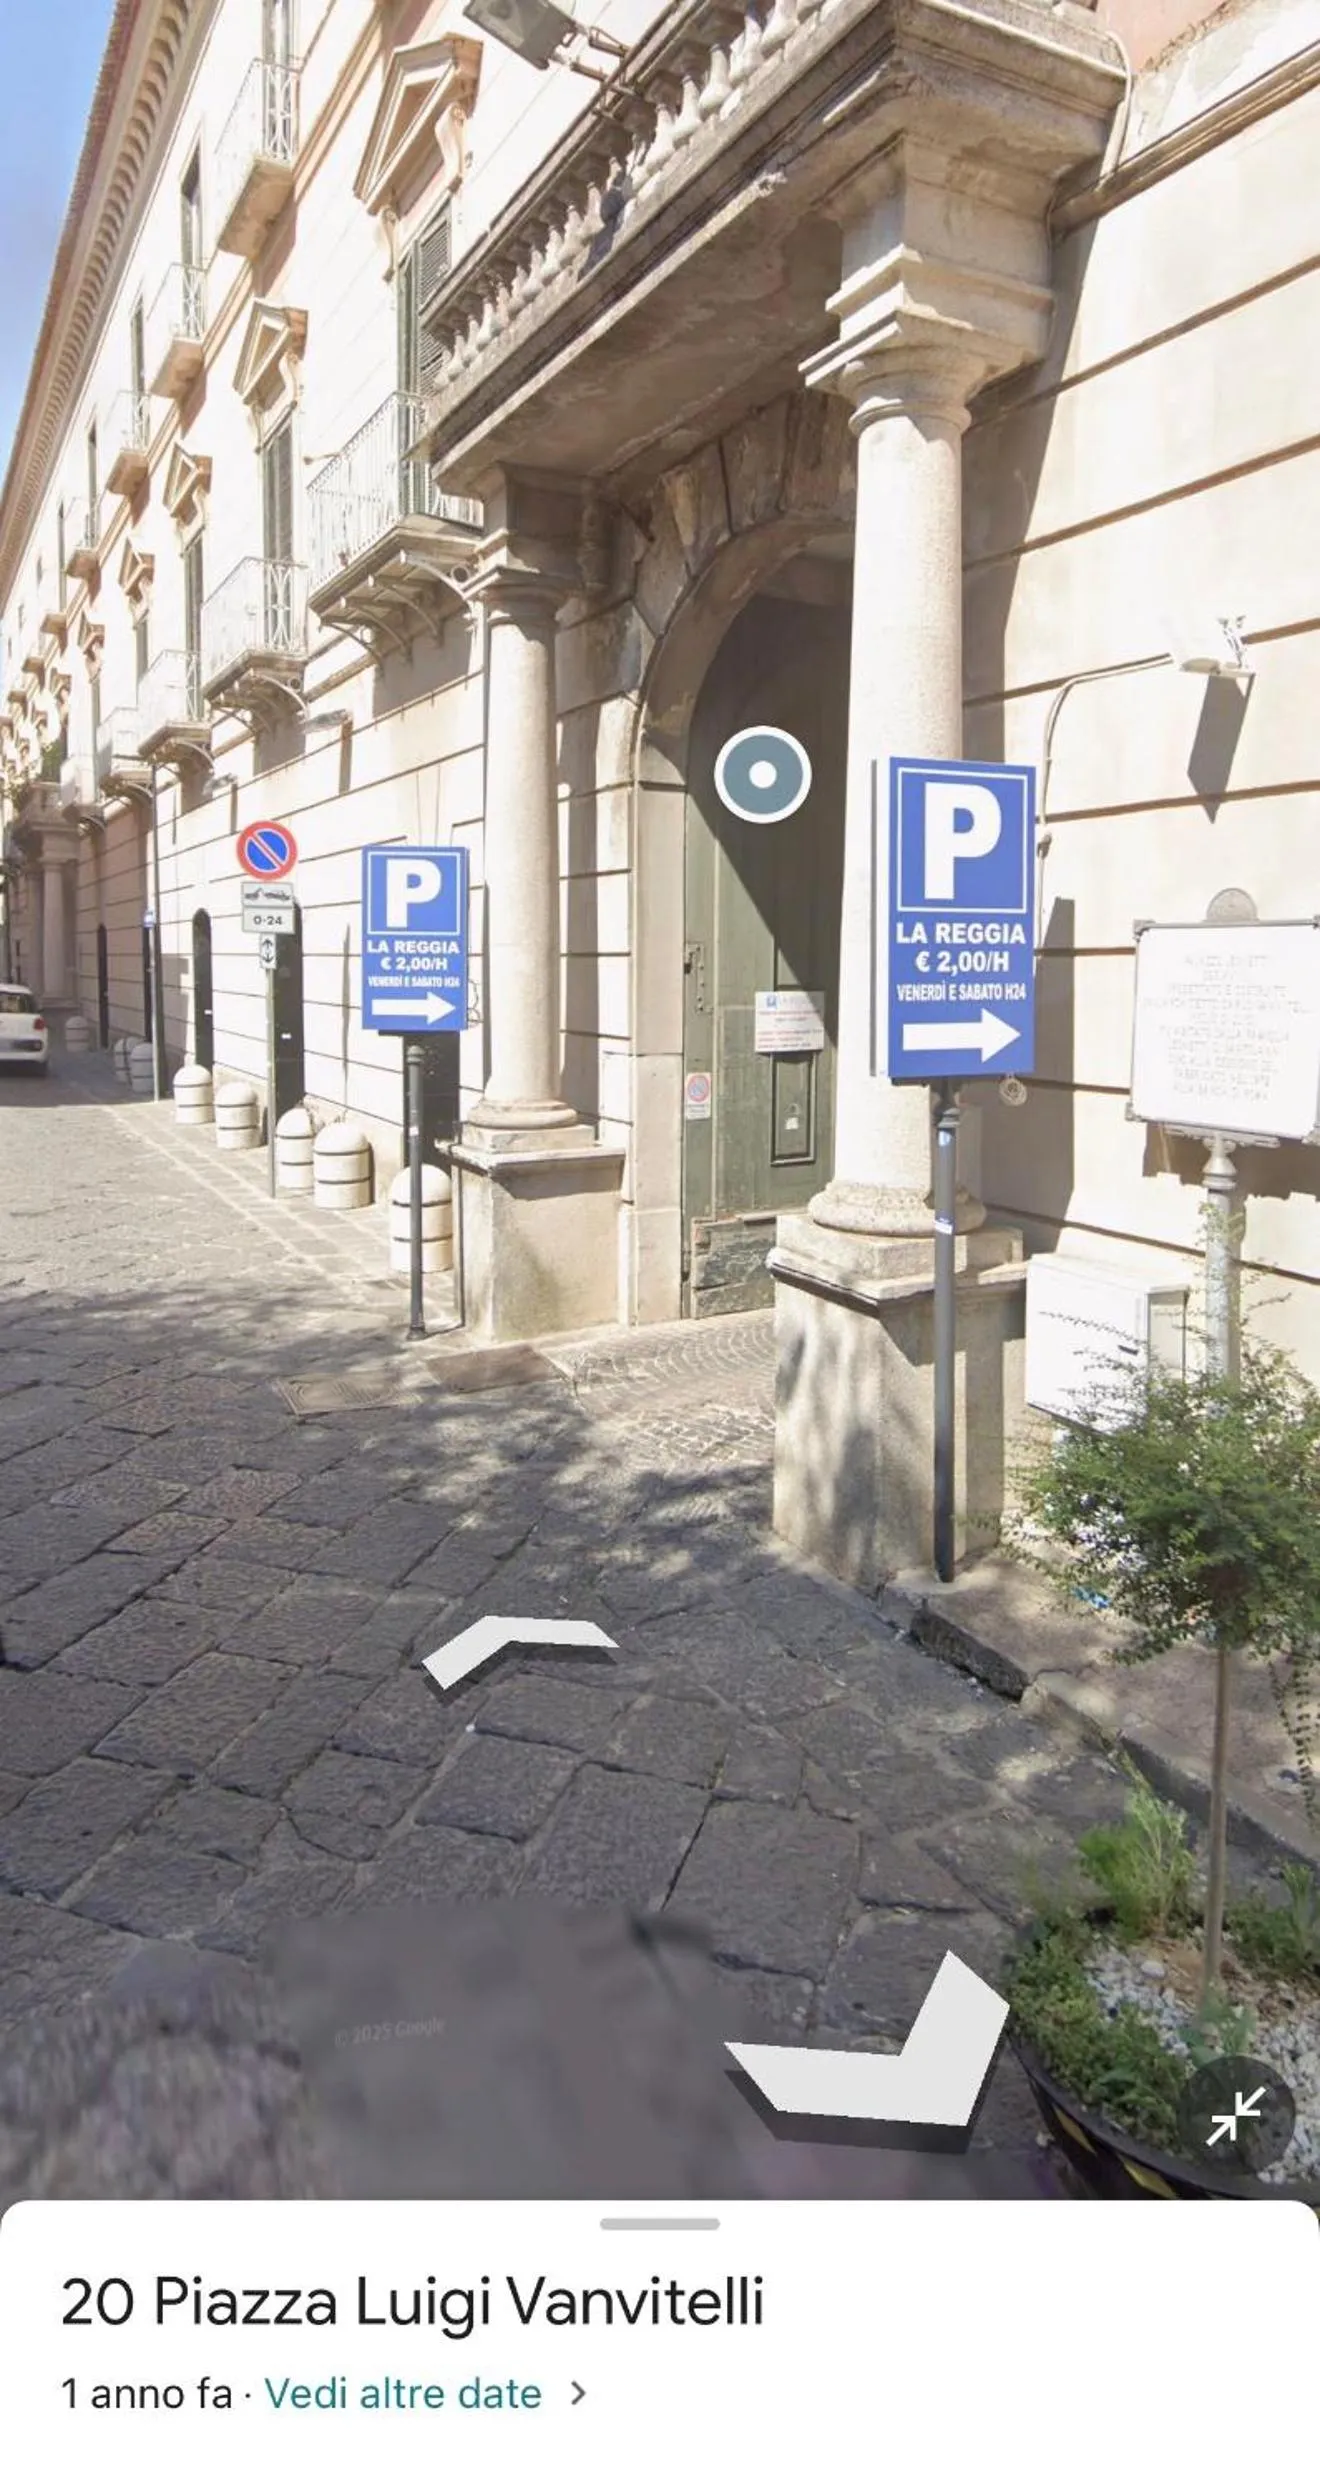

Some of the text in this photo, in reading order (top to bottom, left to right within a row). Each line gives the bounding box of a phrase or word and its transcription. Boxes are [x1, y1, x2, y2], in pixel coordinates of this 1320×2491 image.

[924, 781, 1003, 900] P
[386, 858, 442, 928] P
[253, 915, 283, 926] 0-24
[896, 922, 1026, 944] LA REGGIA
[367, 940, 460, 954] LA REGGIA
[381, 956, 448, 972] € 2,00/H
[915, 951, 1010, 977] € 2,00/H
[948, 983, 957, 1001] E
[958, 982, 1003, 1001] SABATO
[1005, 982, 1027, 1000] H24
